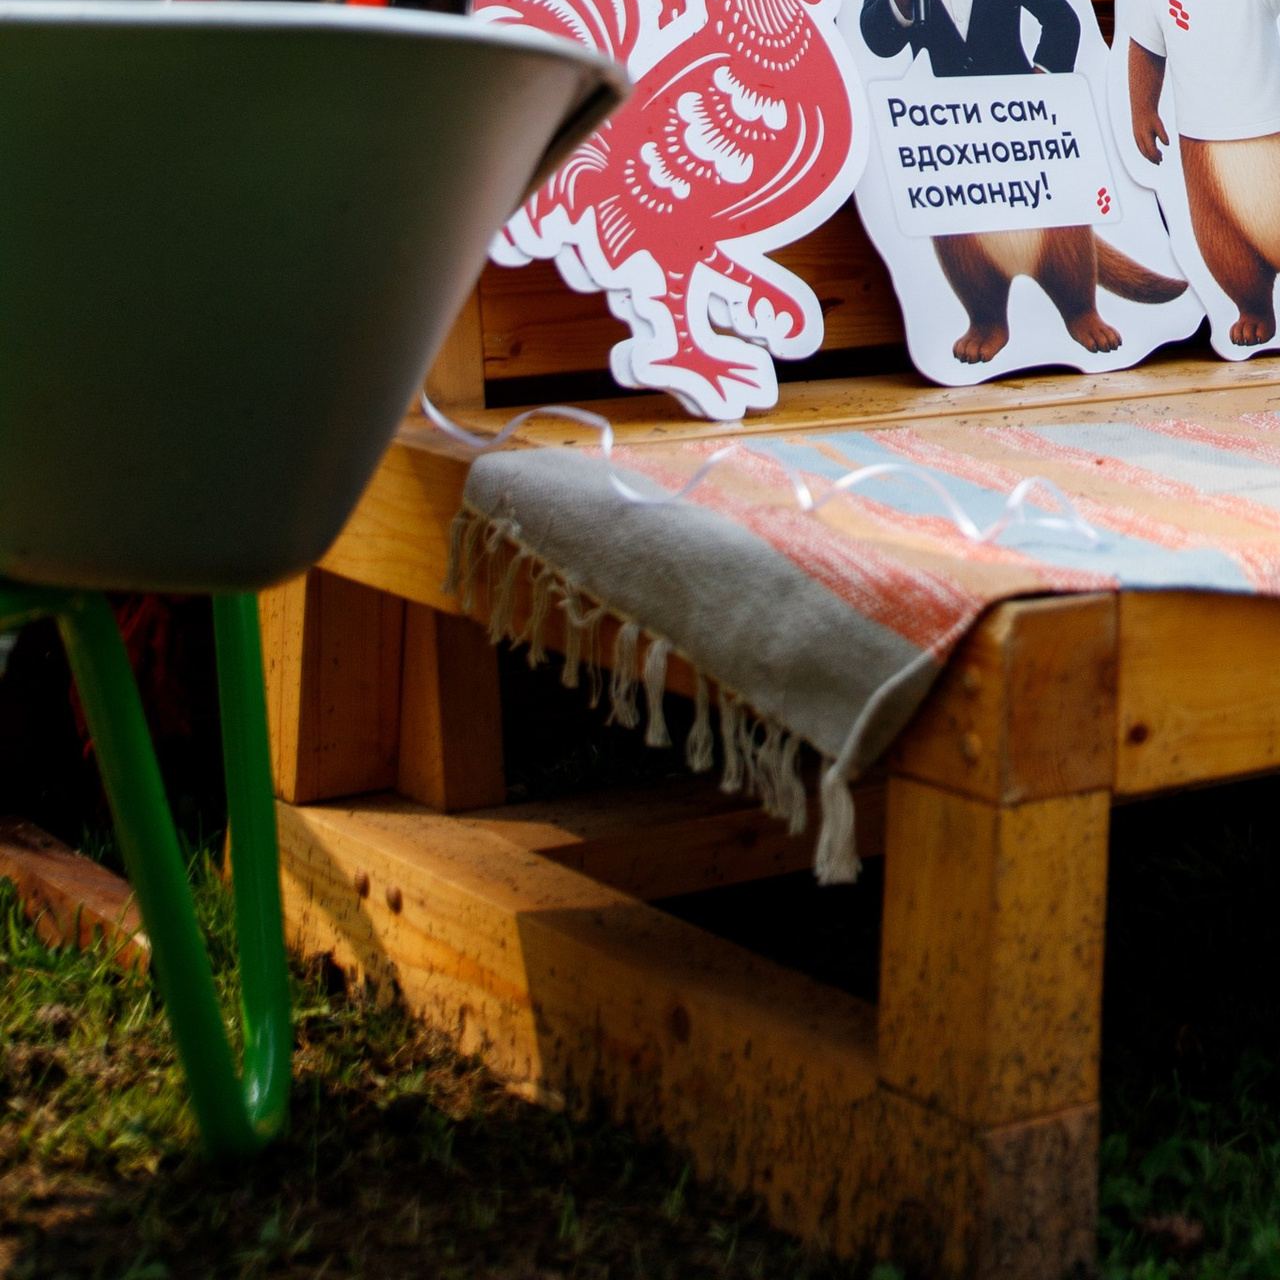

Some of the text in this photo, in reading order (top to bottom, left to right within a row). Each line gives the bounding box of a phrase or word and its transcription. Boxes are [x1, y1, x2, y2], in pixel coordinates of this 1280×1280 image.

[887, 97, 1057, 127] Расти сам,
[898, 131, 1080, 172] вдохновляй
[908, 171, 1052, 209] команду!
